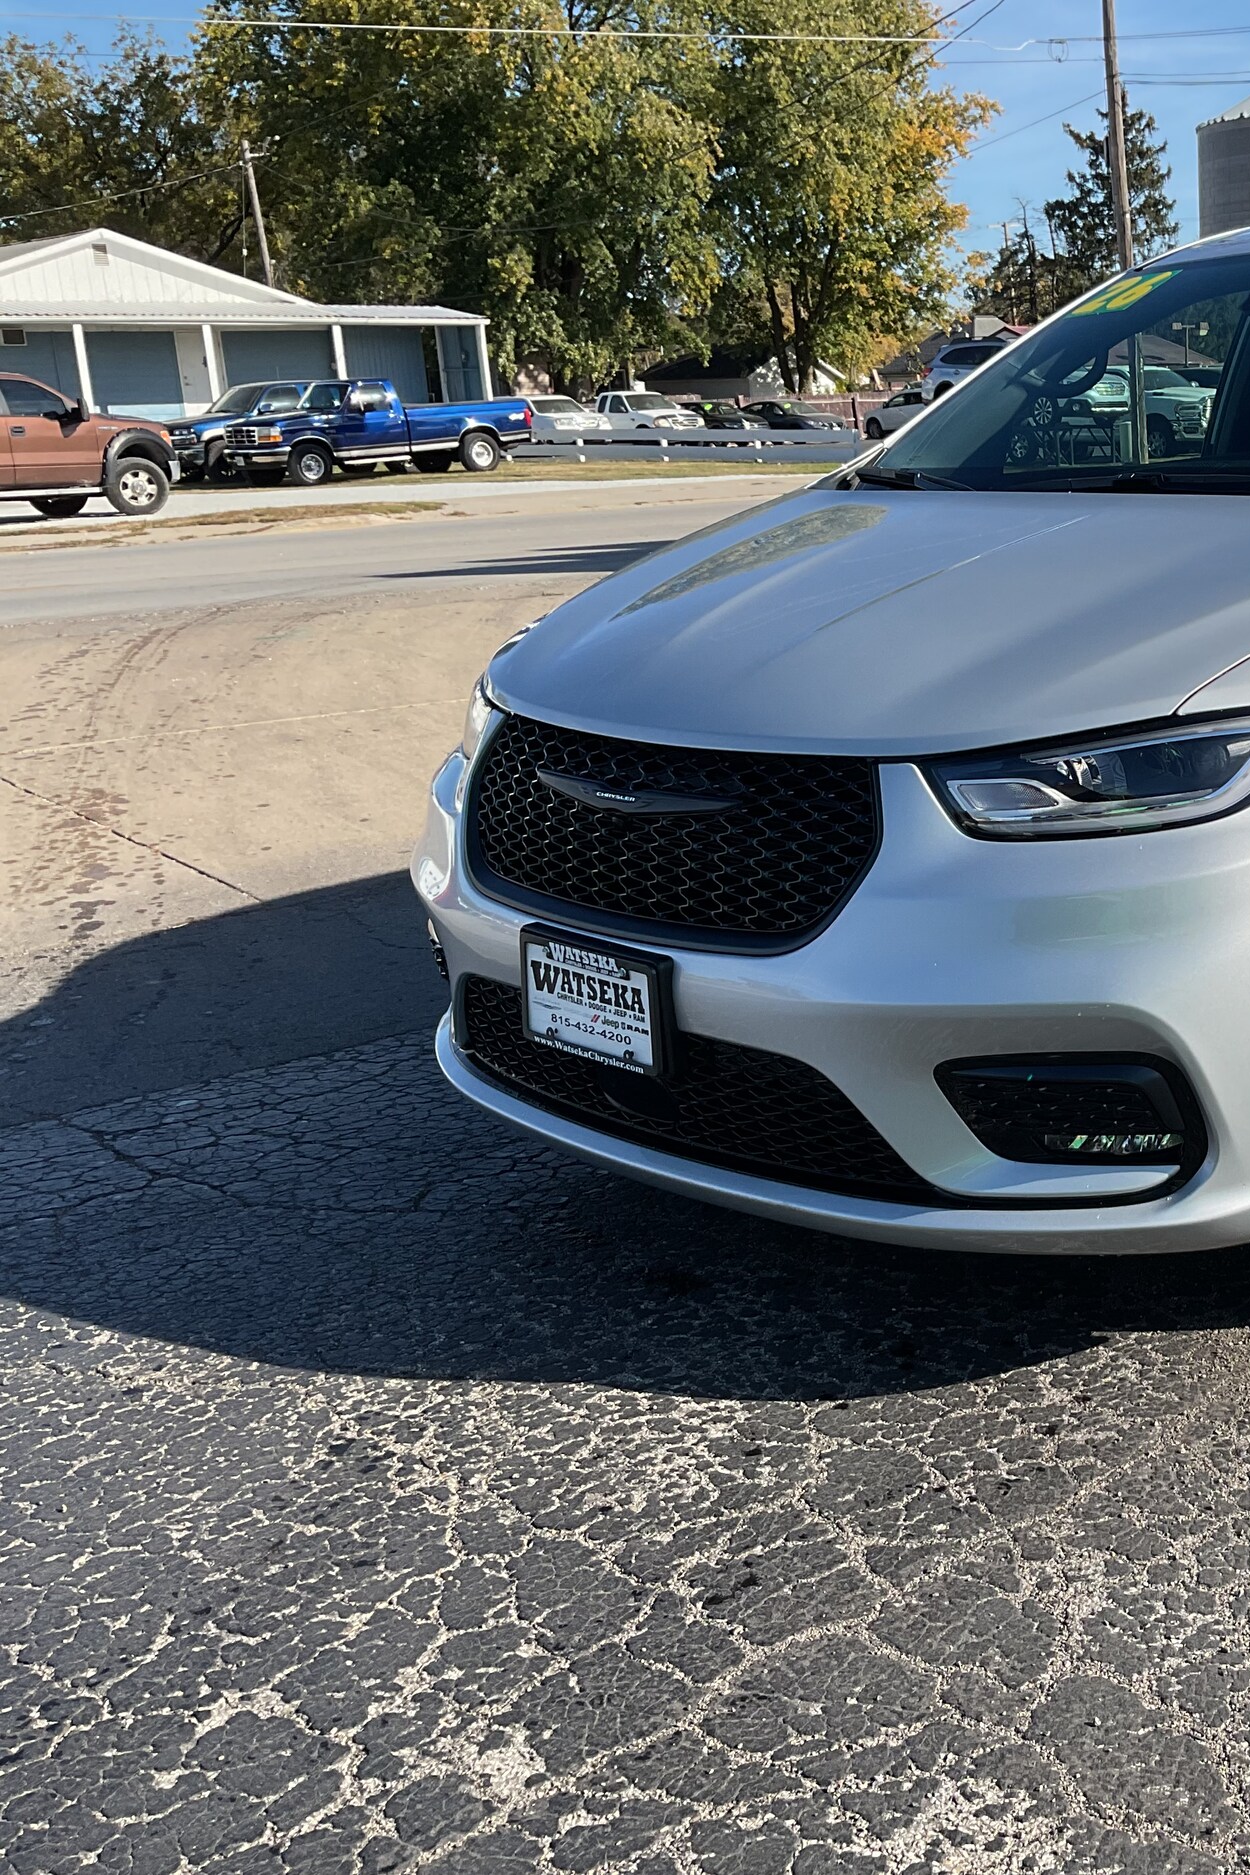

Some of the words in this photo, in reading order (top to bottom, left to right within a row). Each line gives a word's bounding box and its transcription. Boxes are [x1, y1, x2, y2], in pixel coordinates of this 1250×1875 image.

[548, 941, 619, 972] WATSEKA
[530, 960, 646, 1015] WATSEKA
[557, 991, 584, 1007] CHRYSLER
[588, 1001, 608, 1013] DODGE
[612, 1008, 628, 1019] JEEP
[550, 1013, 632, 1046] 815-432-4200
[626, 1024, 650, 1036] RAM
[533, 1035, 645, 1074] www.WatsekaChrysler.com
